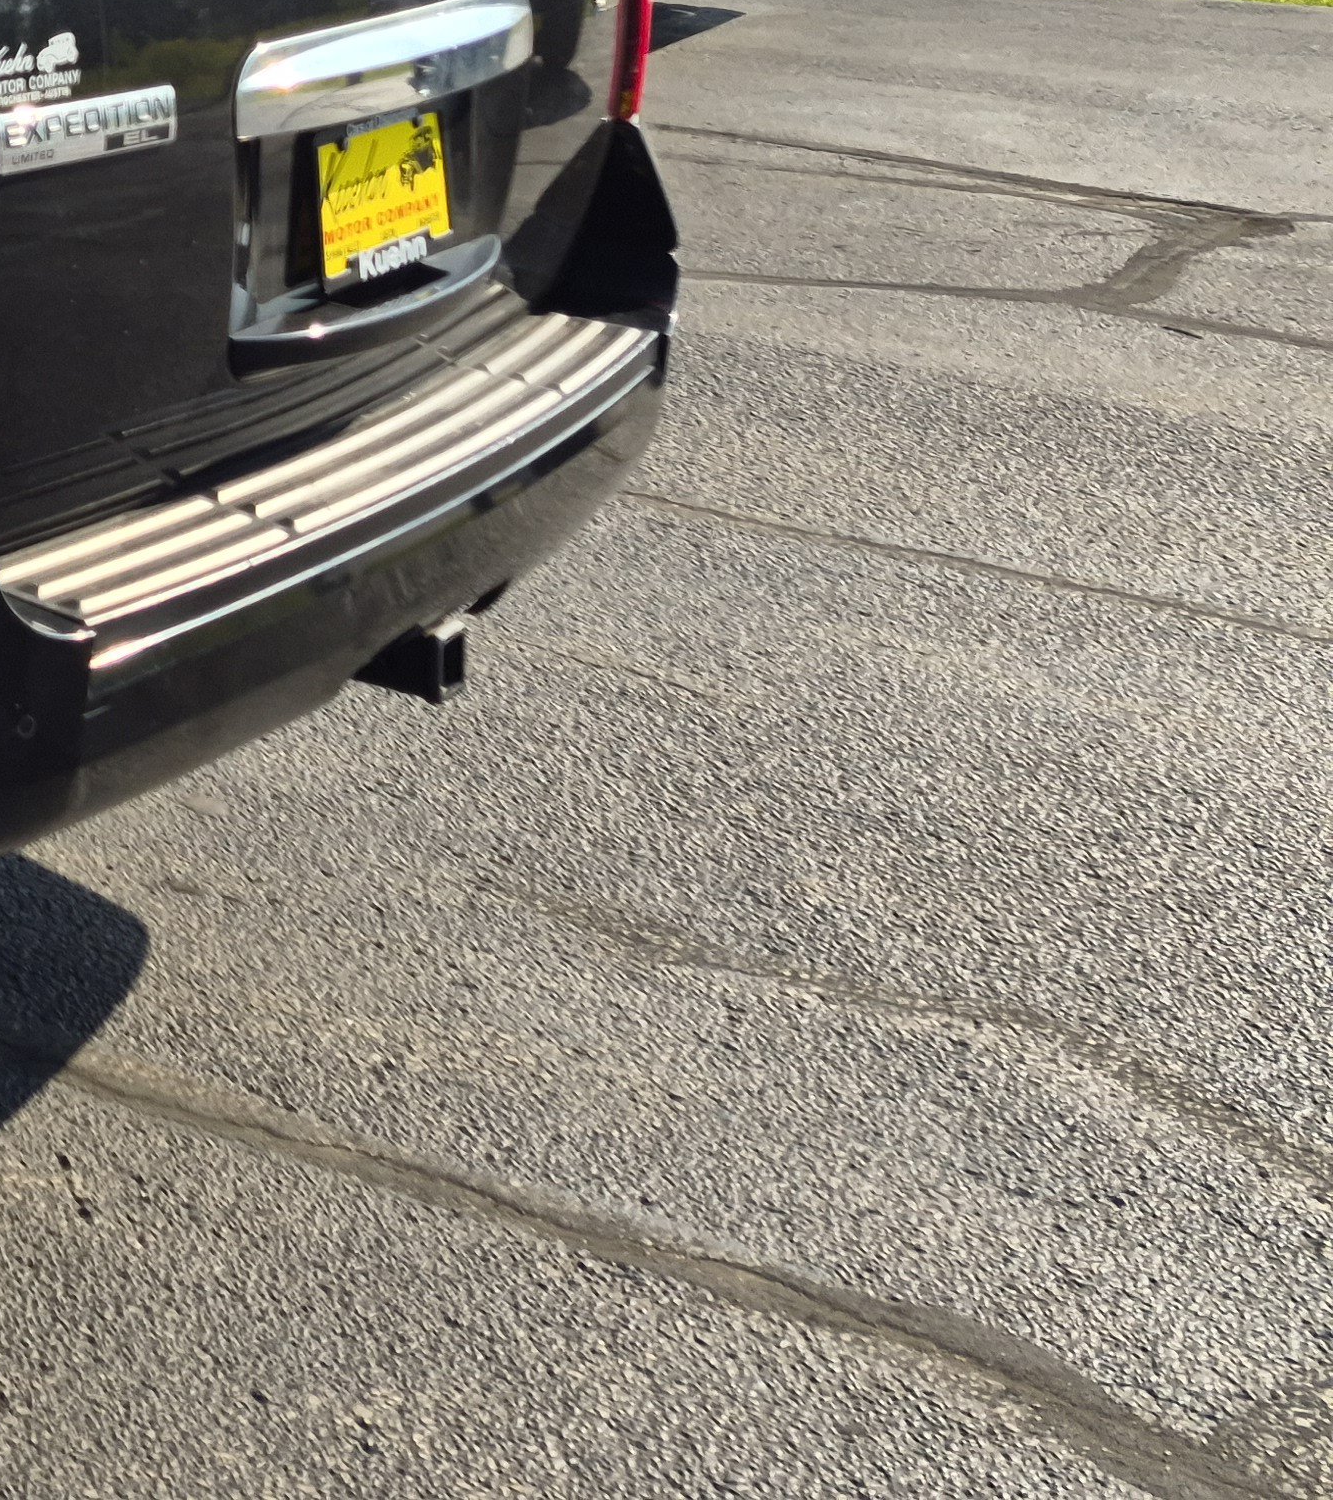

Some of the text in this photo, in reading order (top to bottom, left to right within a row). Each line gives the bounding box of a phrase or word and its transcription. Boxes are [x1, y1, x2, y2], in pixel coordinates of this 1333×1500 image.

[29, 68, 81, 92] COMPANY
[5, 96, 172, 149] EXPEDITION
[122, 129, 159, 148] EL
[11, 149, 55, 167] LIMITED
[324, 216, 373, 246] MOTOR
[376, 193, 439, 227] COMPANY
[359, 235, 428, 282] Kuehn
